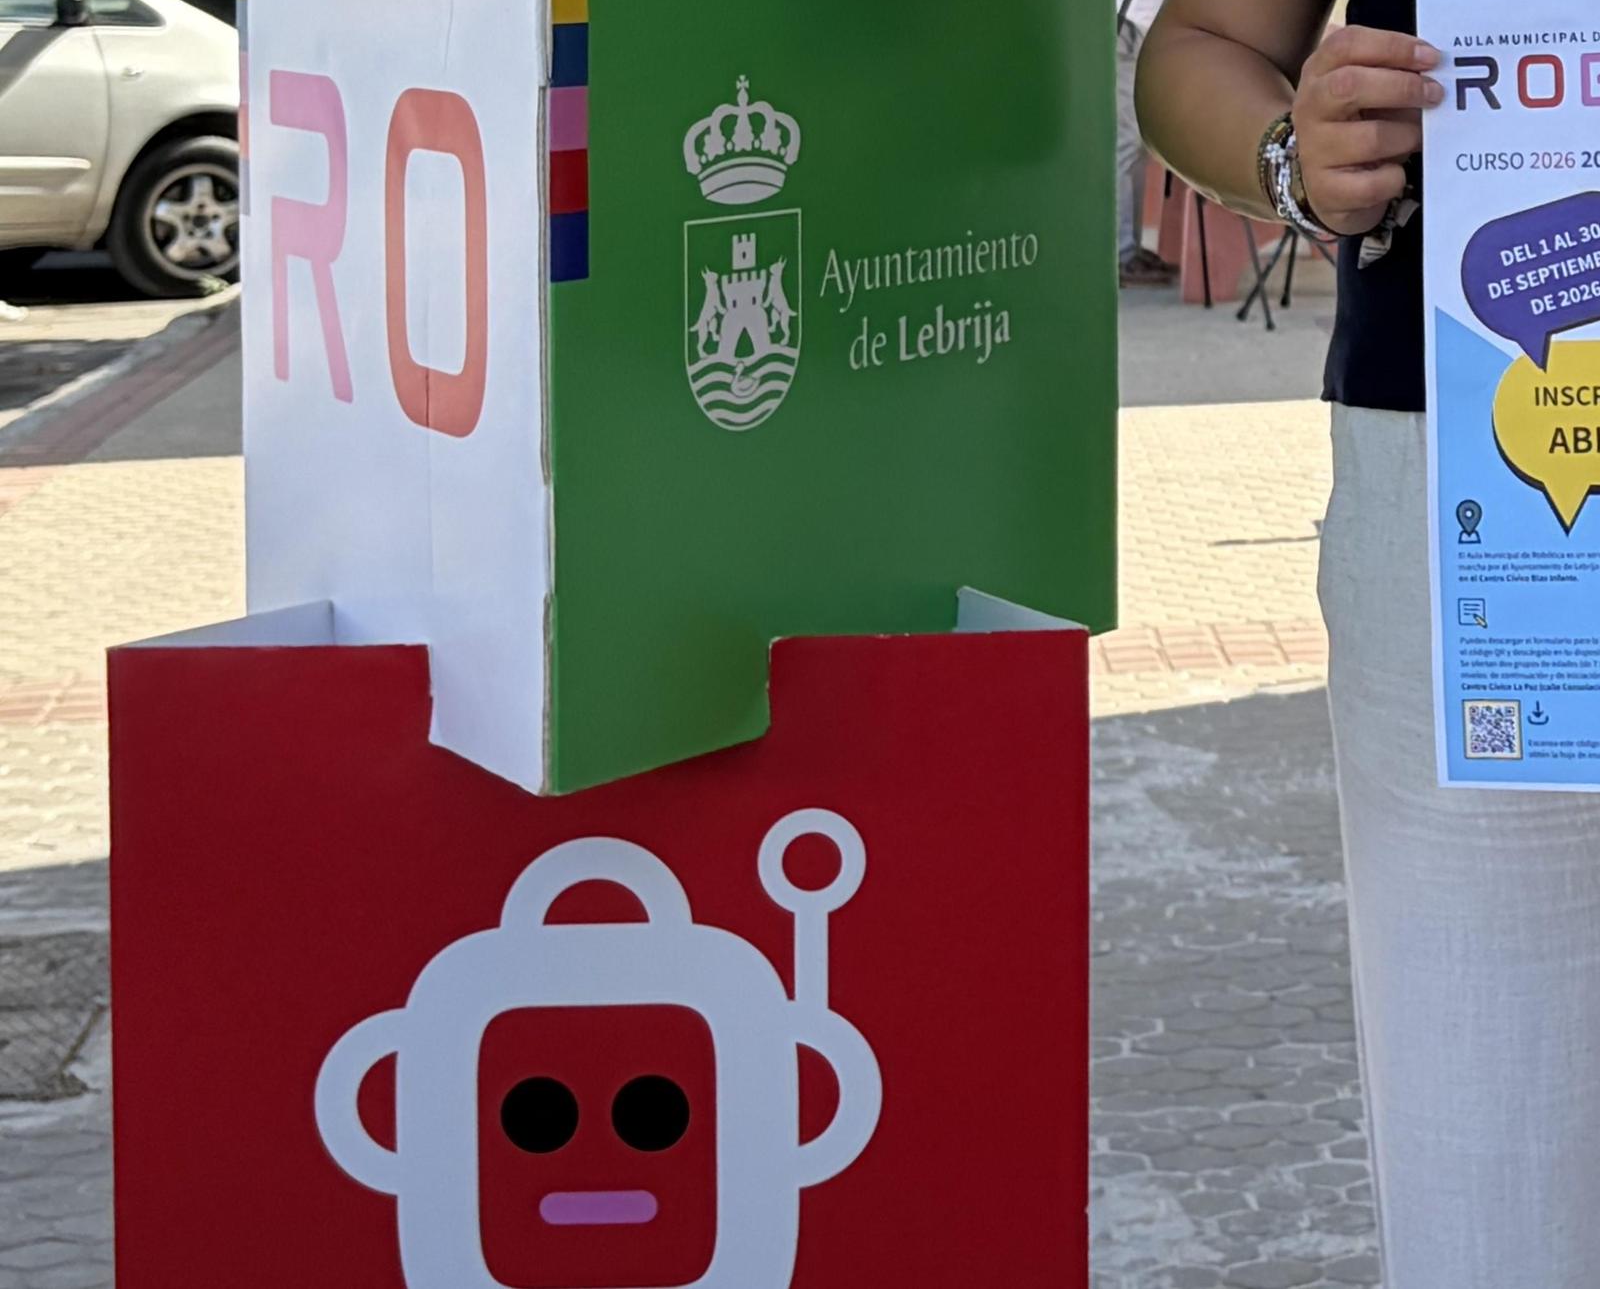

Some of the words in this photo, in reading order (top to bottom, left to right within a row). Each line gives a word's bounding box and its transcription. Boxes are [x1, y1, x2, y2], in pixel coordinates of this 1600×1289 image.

[1453, 35, 1495, 47] AULA
[1499, 31, 1588, 46] MUNICIPAL
[1456, 152, 1524, 172] CURSO
[1530, 150, 1576, 170] 2026
[1500, 243, 1537, 267] DEL
[1539, 239, 1552, 256] 1
[1554, 231, 1578, 251] AL
[819, 230, 1039, 314] Ayuntamiento
[1487, 278, 1515, 300] DE
[1530, 294, 1557, 316] DE
[849, 316, 887, 370] de
[898, 300, 1011, 364] Lebrija
